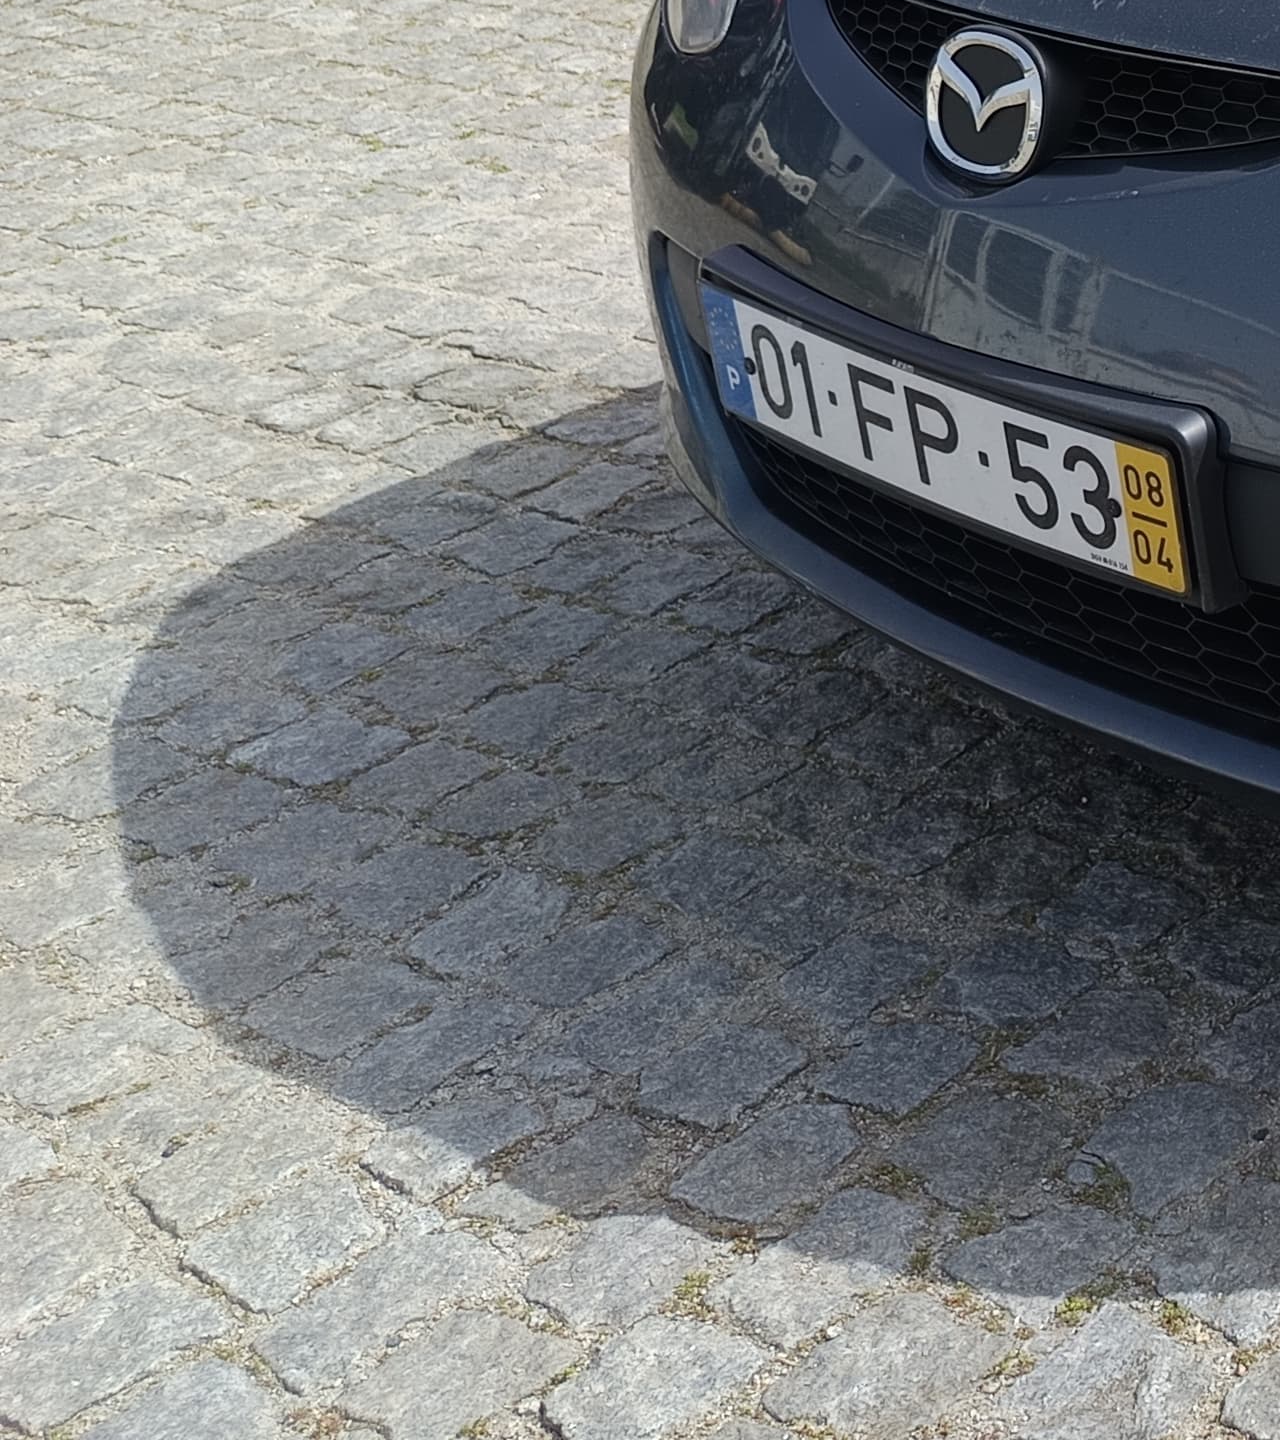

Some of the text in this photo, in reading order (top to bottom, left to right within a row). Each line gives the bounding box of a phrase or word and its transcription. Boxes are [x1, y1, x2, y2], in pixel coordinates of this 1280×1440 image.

[727, 364, 741, 391] P
[1123, 464, 1165, 508] 08
[1133, 529, 1175, 574] 04
